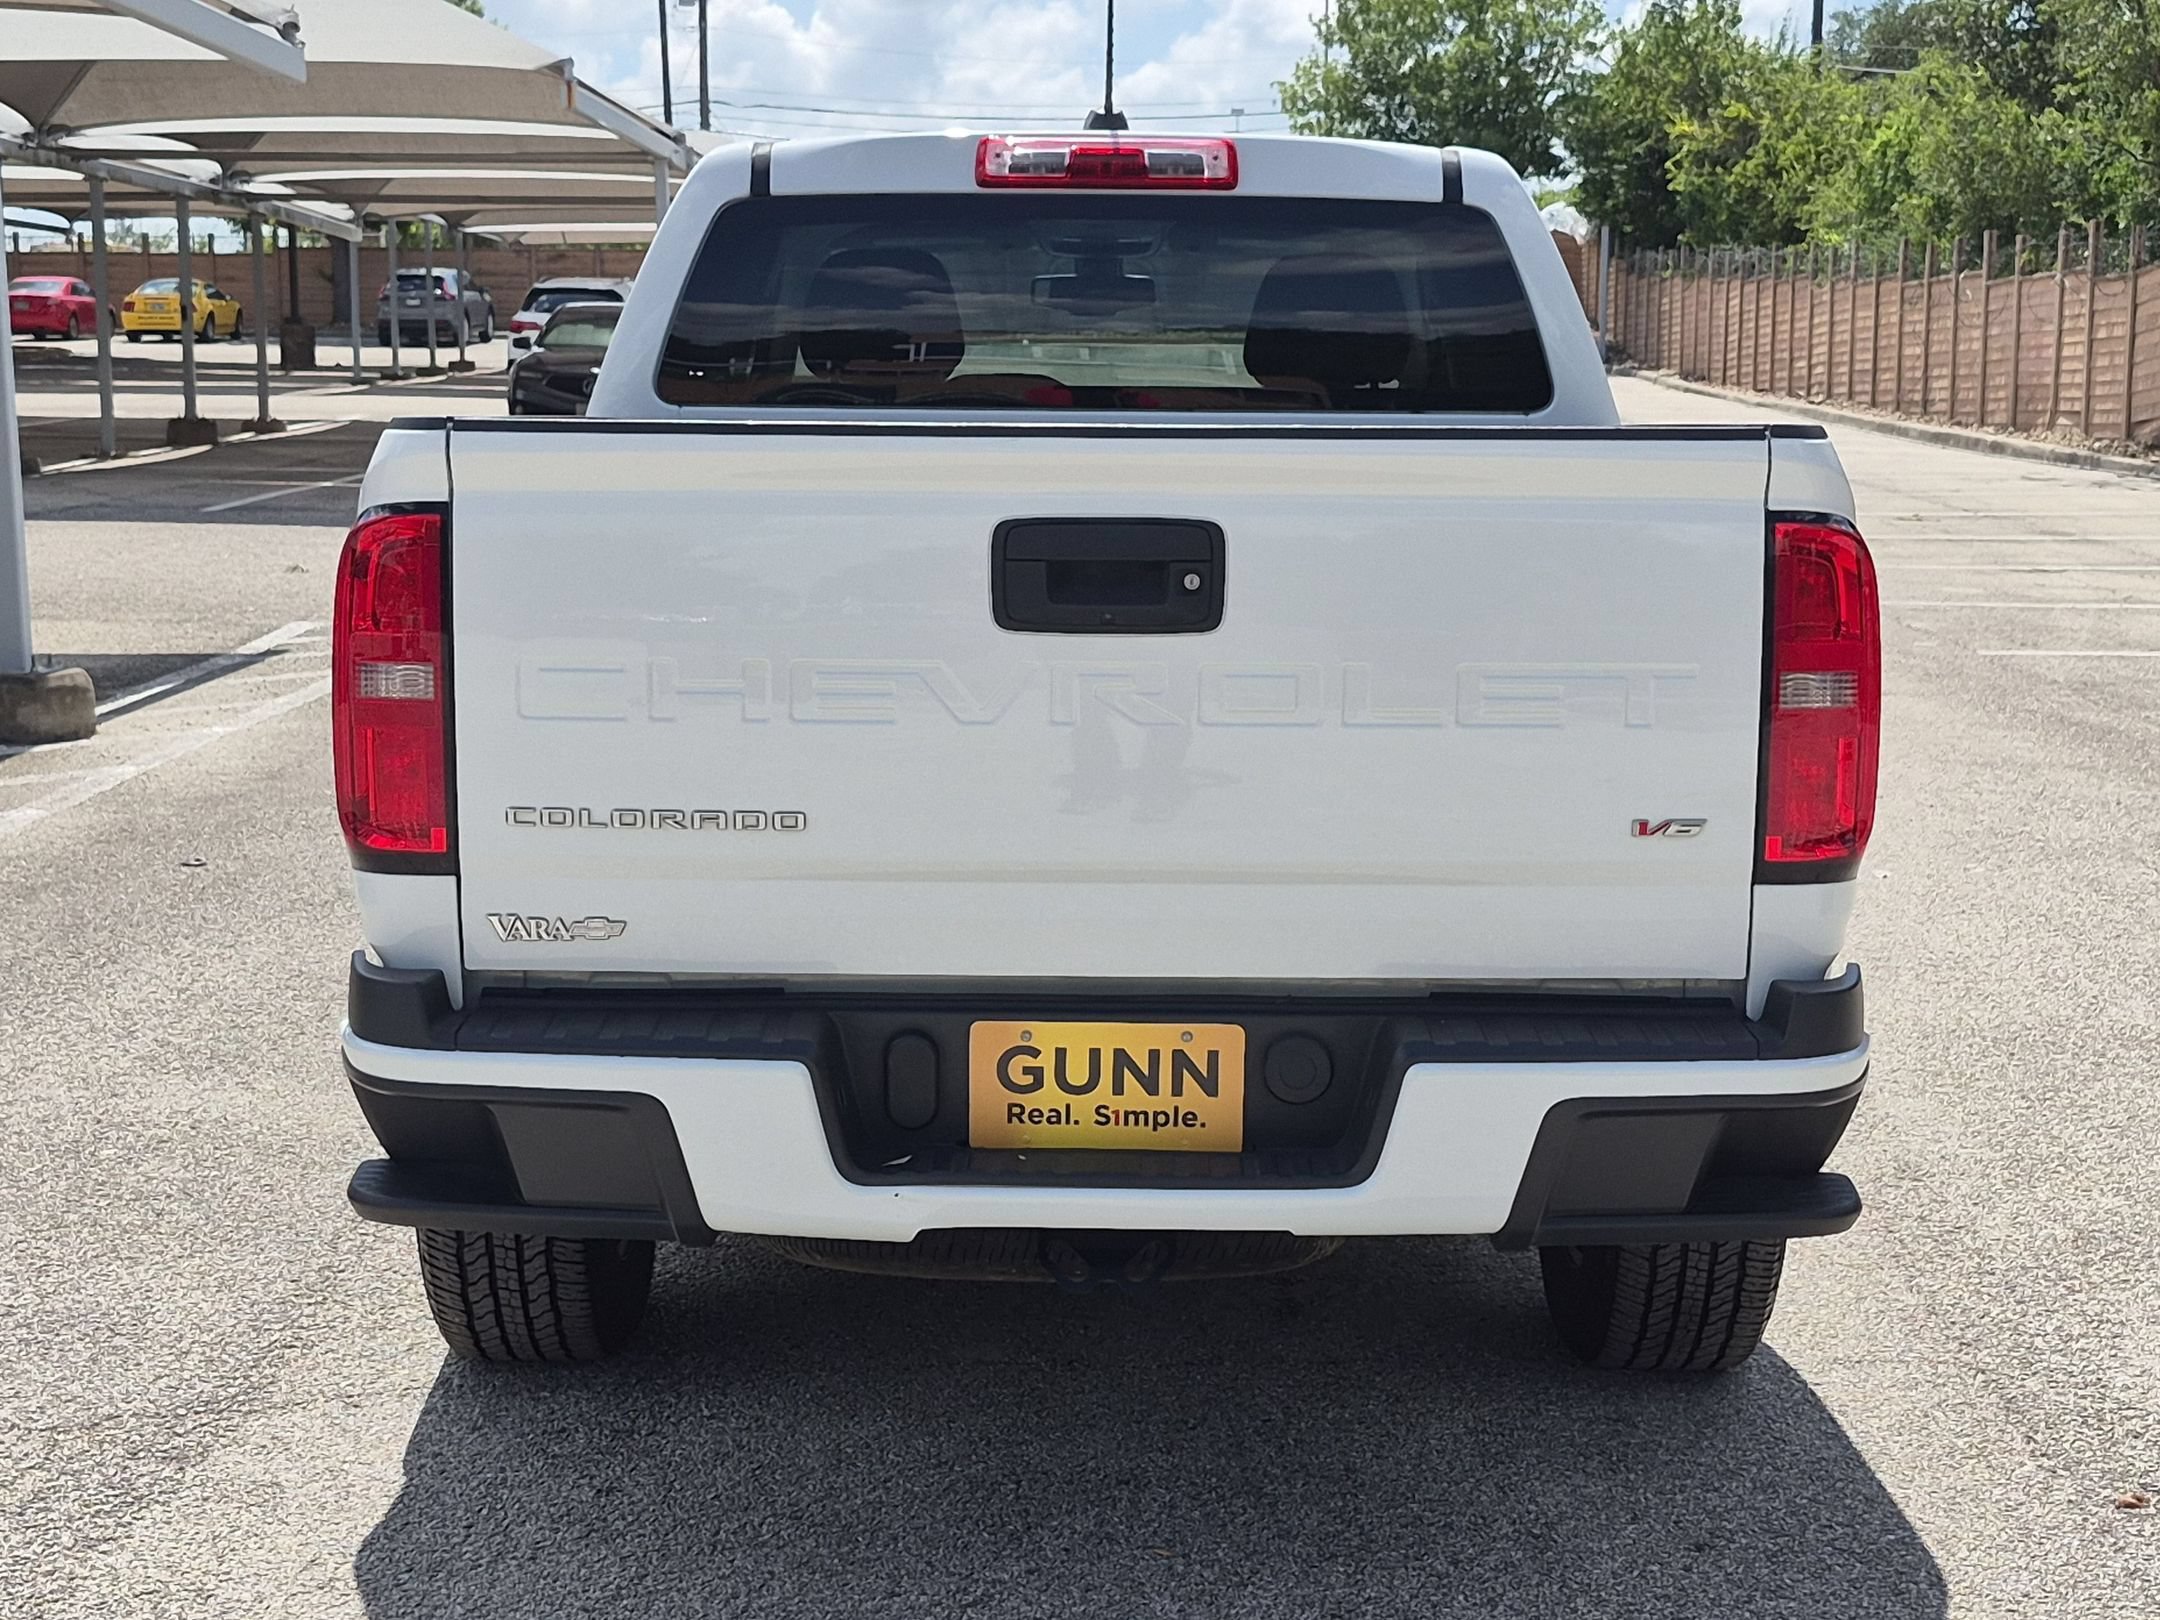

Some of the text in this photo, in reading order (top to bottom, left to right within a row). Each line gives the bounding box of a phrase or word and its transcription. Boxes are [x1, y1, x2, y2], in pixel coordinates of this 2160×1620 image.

[515, 656, 1699, 728] CHEVROLET
[505, 806, 807, 832] COLORADO
[1631, 818, 1708, 838] V6
[486, 912, 575, 942] VARA
[996, 1045, 1219, 1098] GUNN
[1007, 1103, 1081, 1127] Real.
